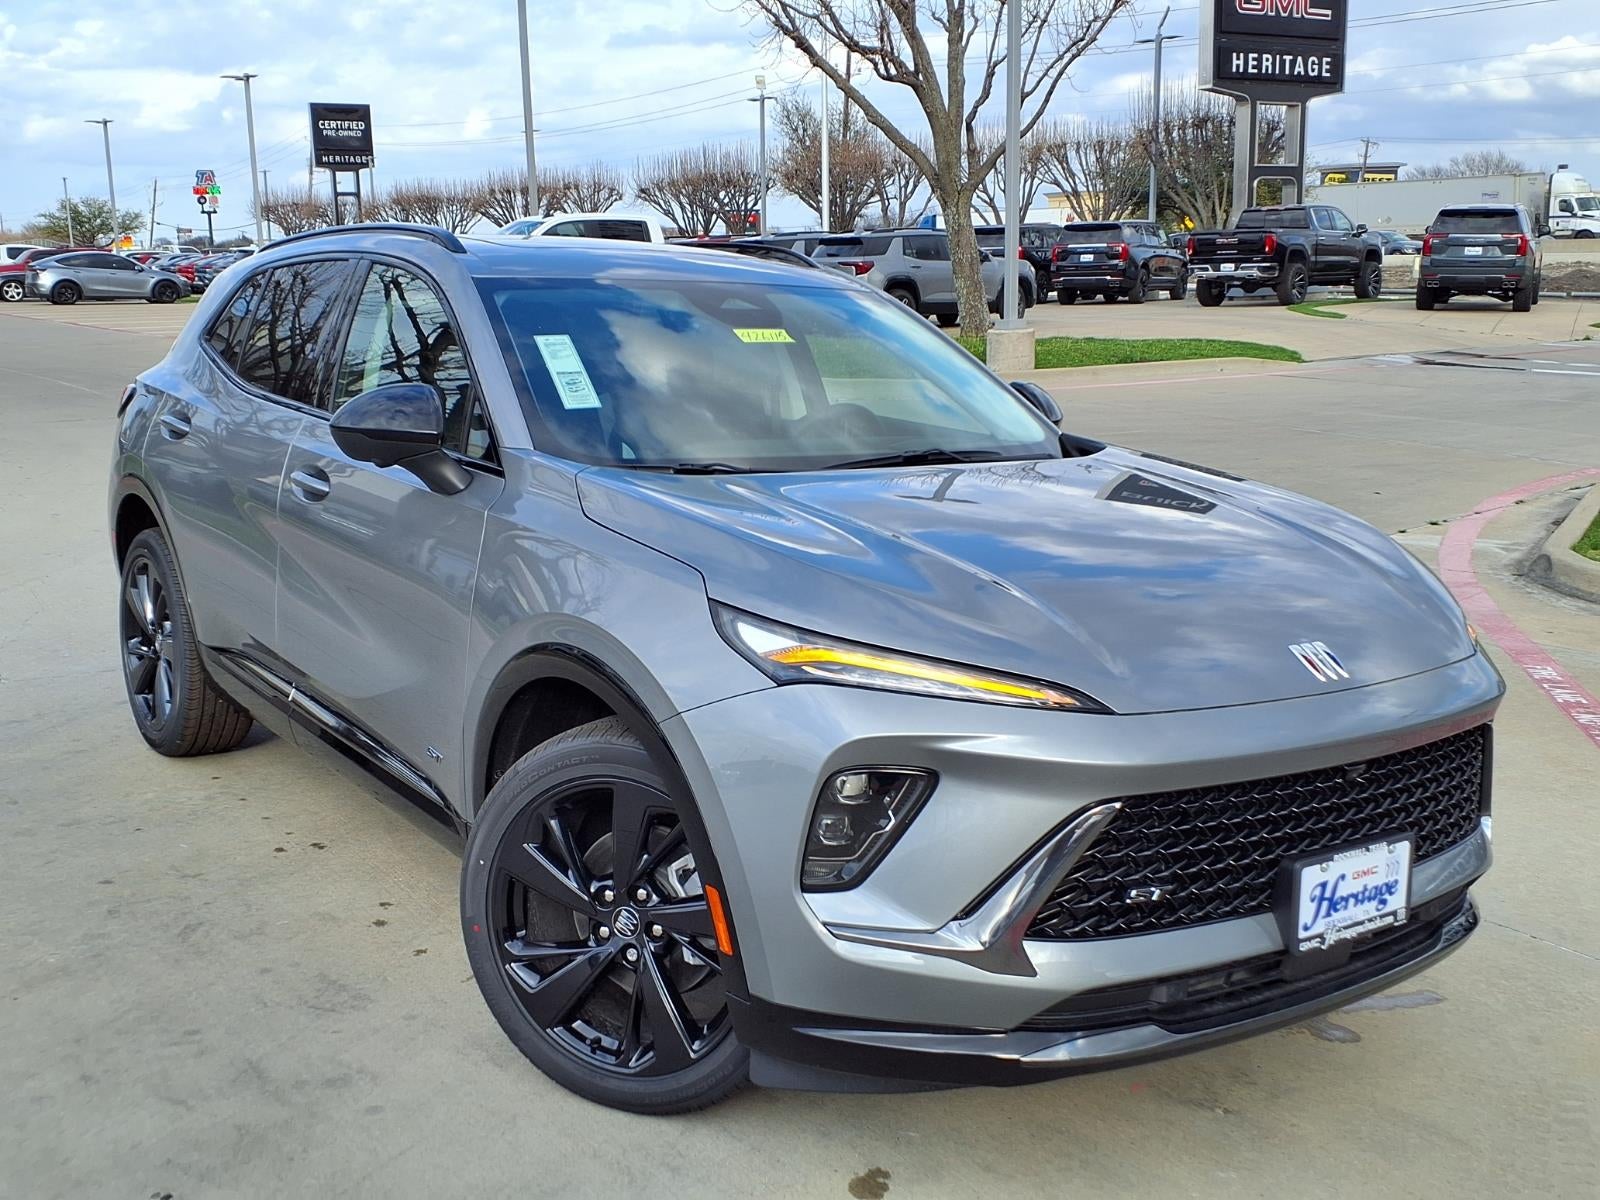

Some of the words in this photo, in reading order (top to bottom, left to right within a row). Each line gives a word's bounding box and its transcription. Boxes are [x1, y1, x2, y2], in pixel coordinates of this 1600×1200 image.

[1235, 0, 1332, 20] GMC
[1231, 52, 1332, 77] HERITAGE
[318, 120, 365, 130] CERTIFIED
[322, 129, 362, 137] PRE-OWNED
[321, 155, 368, 163] HERITAGE
[1352, 865, 1379, 880] GMC
[1302, 873, 1399, 932] Heritage
